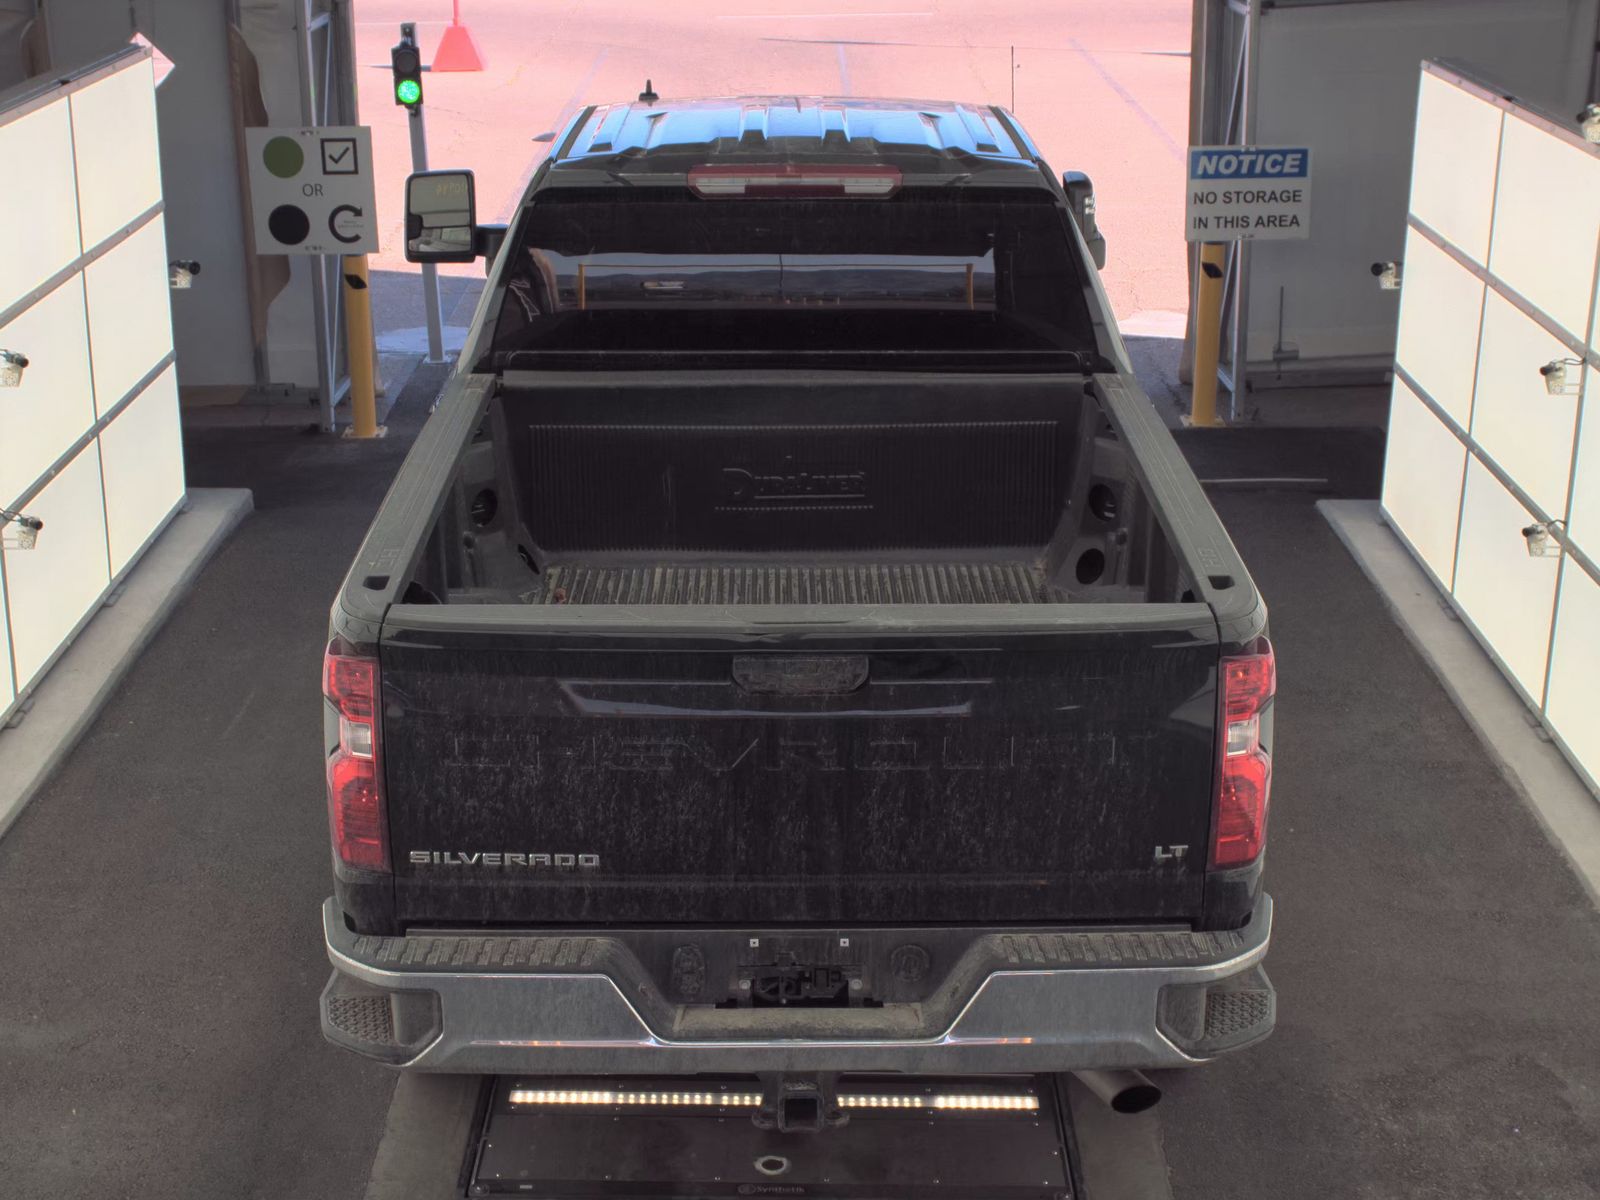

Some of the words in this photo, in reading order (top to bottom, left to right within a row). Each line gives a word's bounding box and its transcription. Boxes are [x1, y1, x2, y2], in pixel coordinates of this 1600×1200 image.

[1197, 153, 1302, 175] NOTICE
[302, 183, 324, 197] OR
[1193, 191, 1218, 205] NO
[1222, 189, 1303, 204] STORAGE
[1193, 216, 1209, 229] IN
[1214, 215, 1250, 229] THIS
[1254, 214, 1301, 228] AREA
[409, 850, 600, 866] SILVERADO
[1155, 844, 1189, 859] LT
